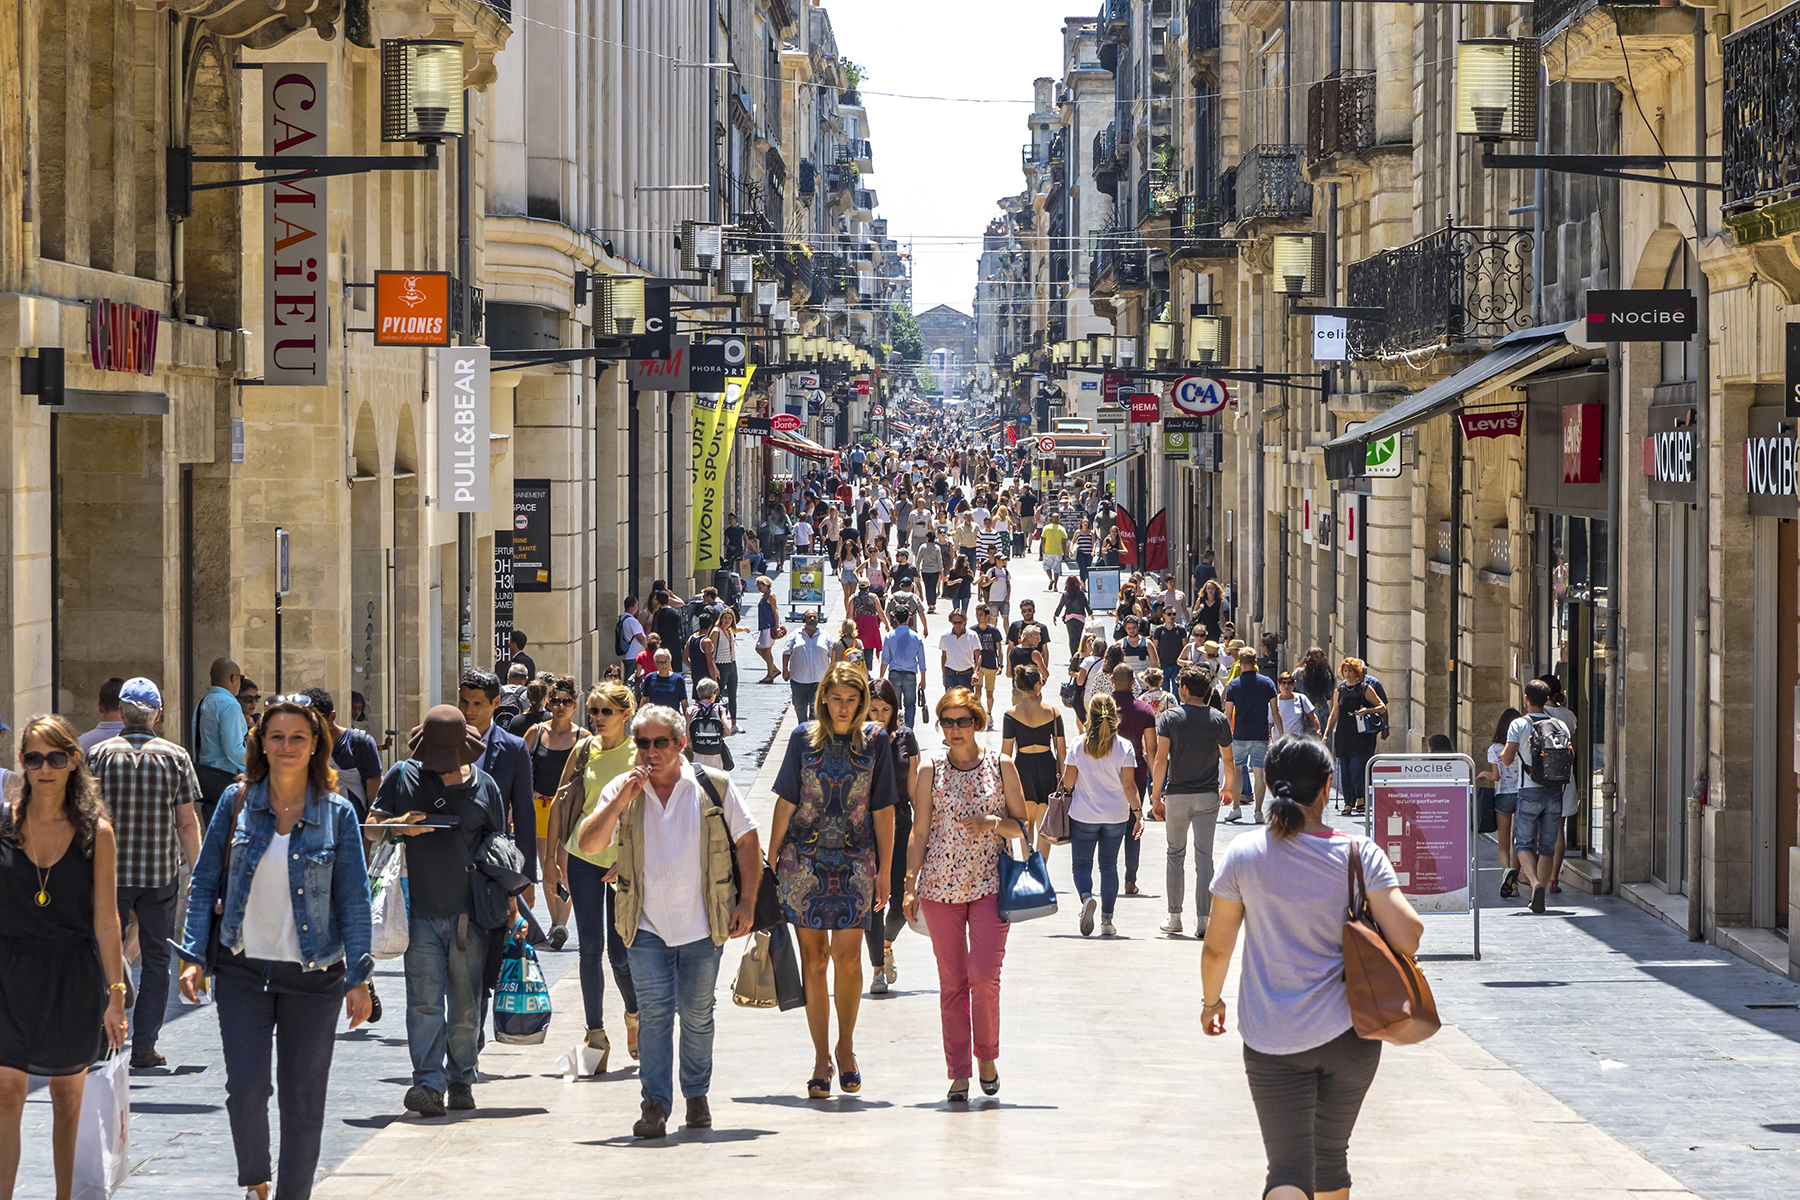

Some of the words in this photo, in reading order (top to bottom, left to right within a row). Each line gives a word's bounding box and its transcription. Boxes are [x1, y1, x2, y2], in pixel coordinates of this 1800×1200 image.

[273, 74, 317, 375] CAMAÏEU
[382, 316, 442, 334] PYLONES
[1317, 328, 1344, 339] celi
[639, 348, 683, 377] H&M
[1181, 383, 1219, 404] C&A
[454, 358, 476, 502] PULL&BEAR
[738, 428, 768, 436] COURIR
[774, 421, 798, 429] Dorée
[699, 487, 714, 562] VIVONS
